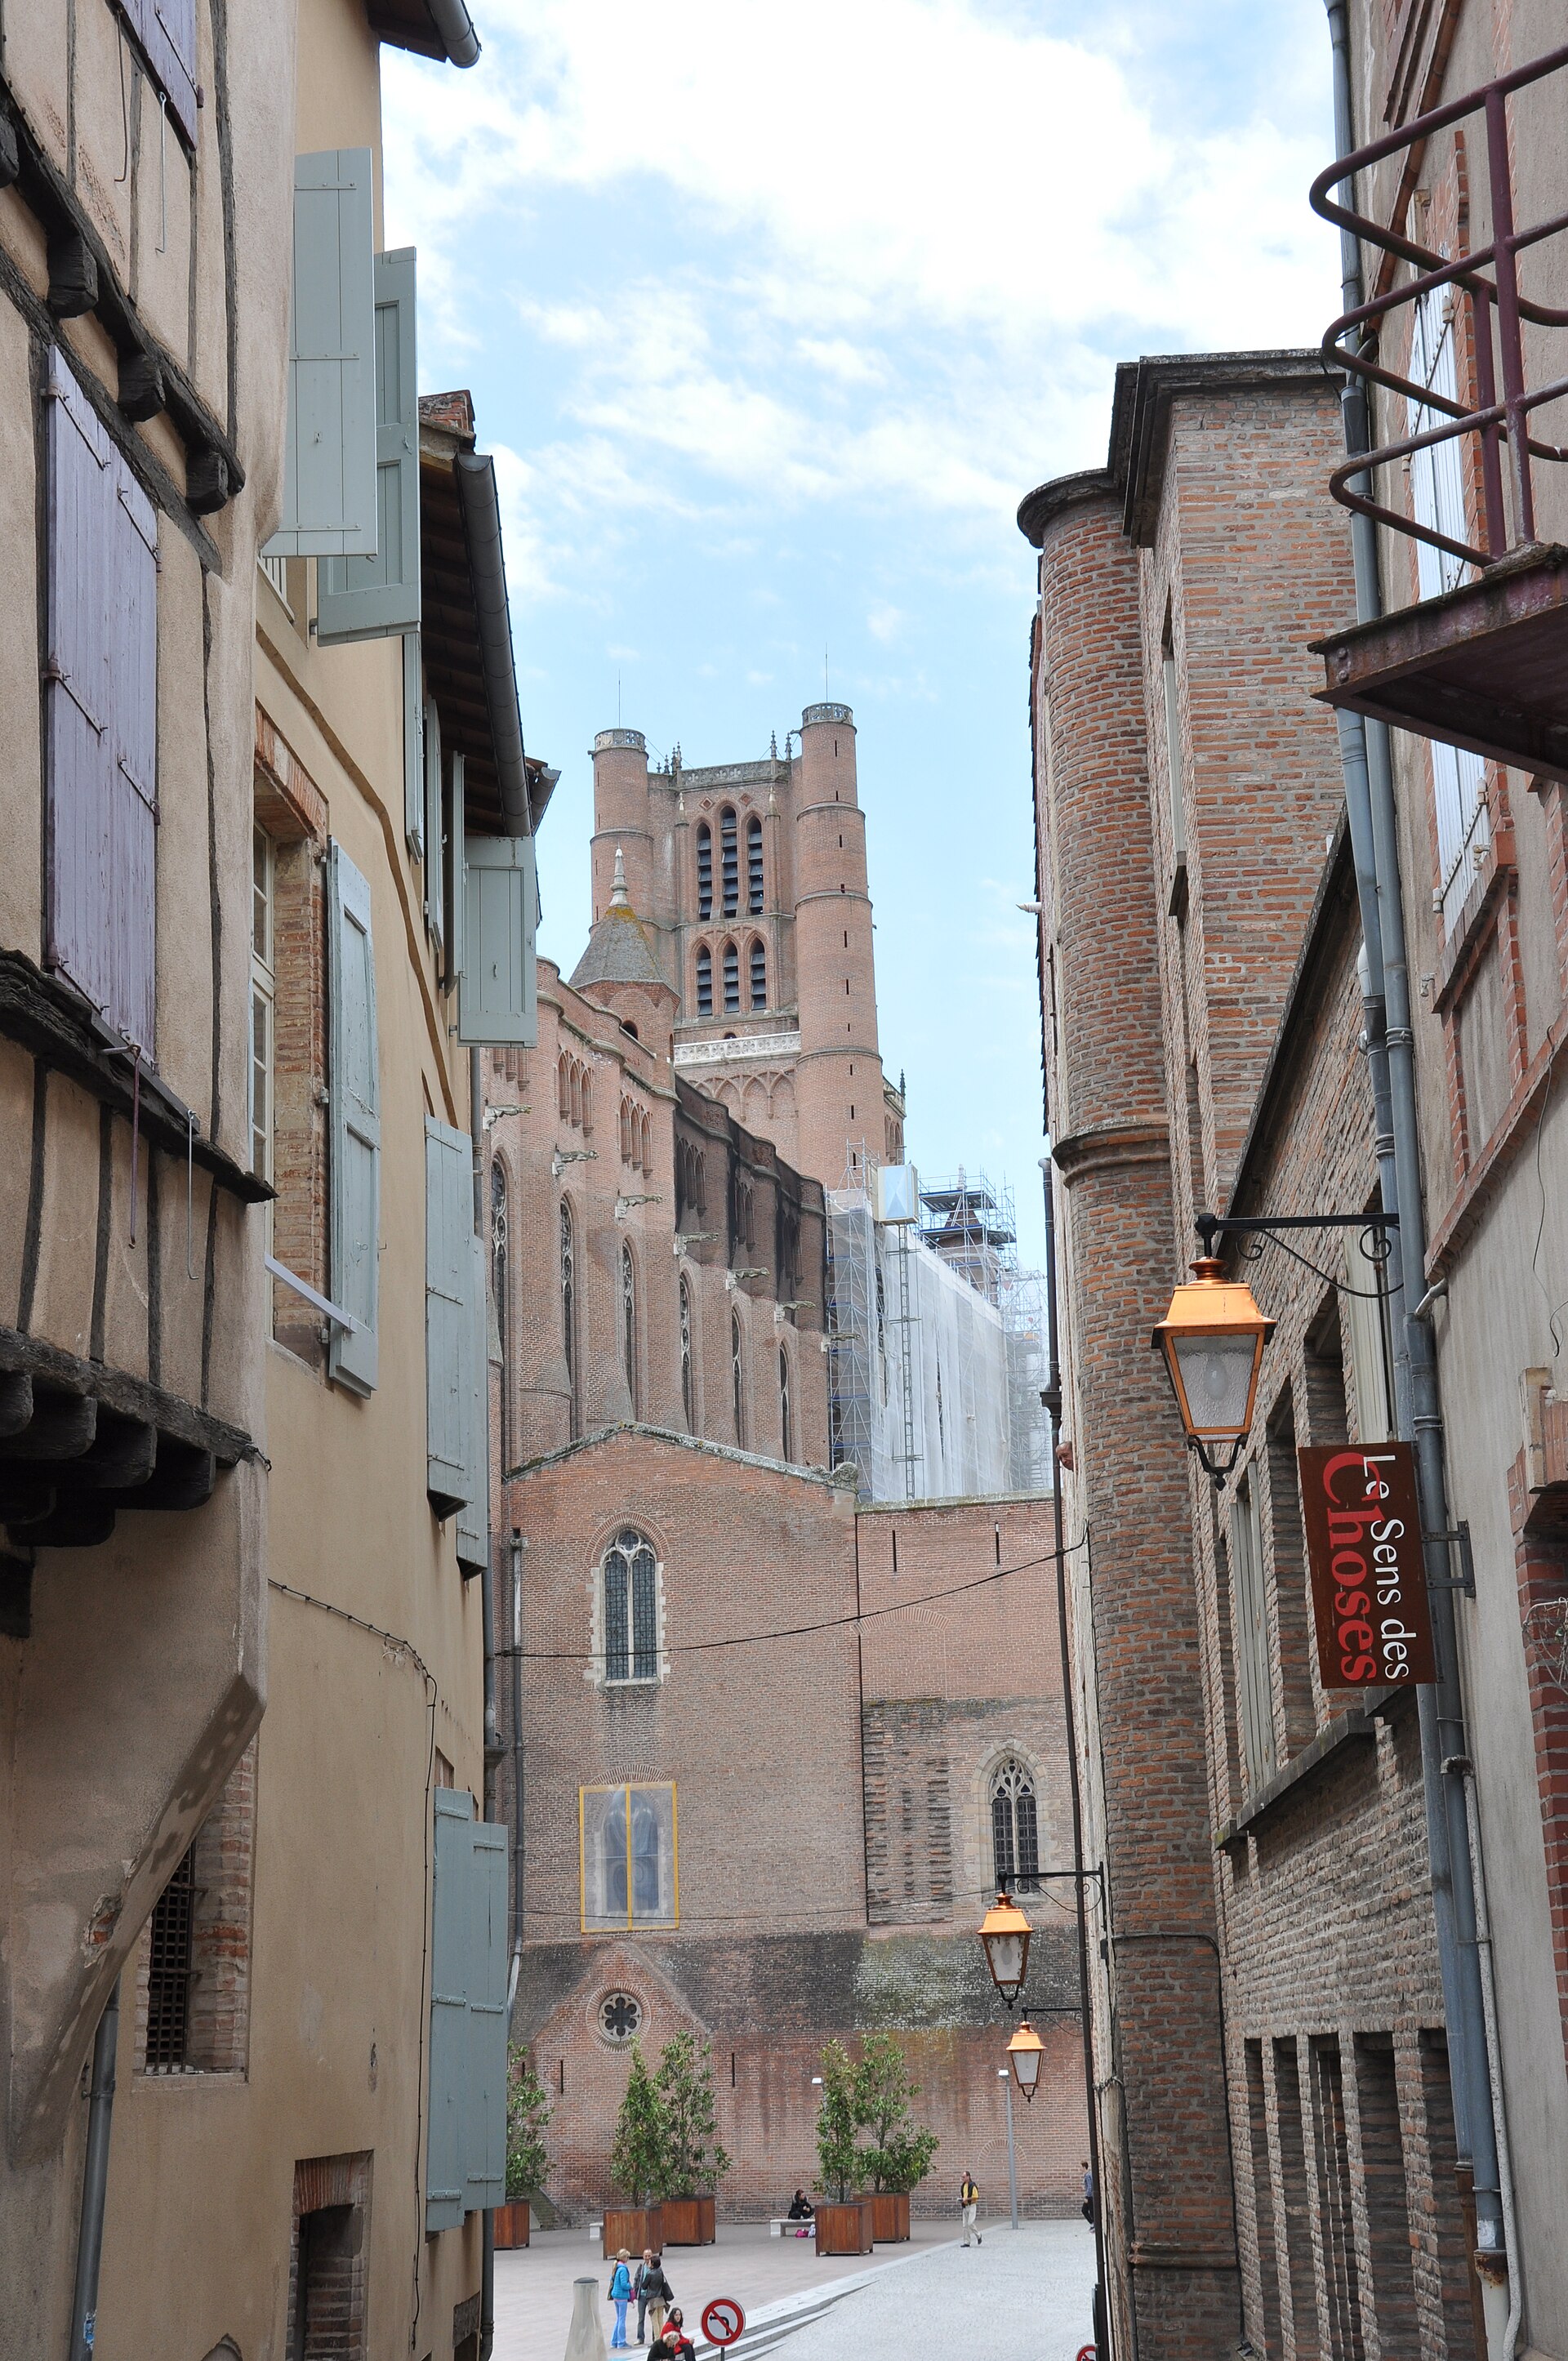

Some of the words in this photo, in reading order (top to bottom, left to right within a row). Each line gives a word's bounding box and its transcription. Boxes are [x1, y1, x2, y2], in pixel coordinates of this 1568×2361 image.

[1363, 1454, 1396, 1499] Le
[1323, 1452, 1385, 1681] Choses
[1370, 1519, 1405, 1606] Sens
[1380, 1619, 1417, 1680] des
